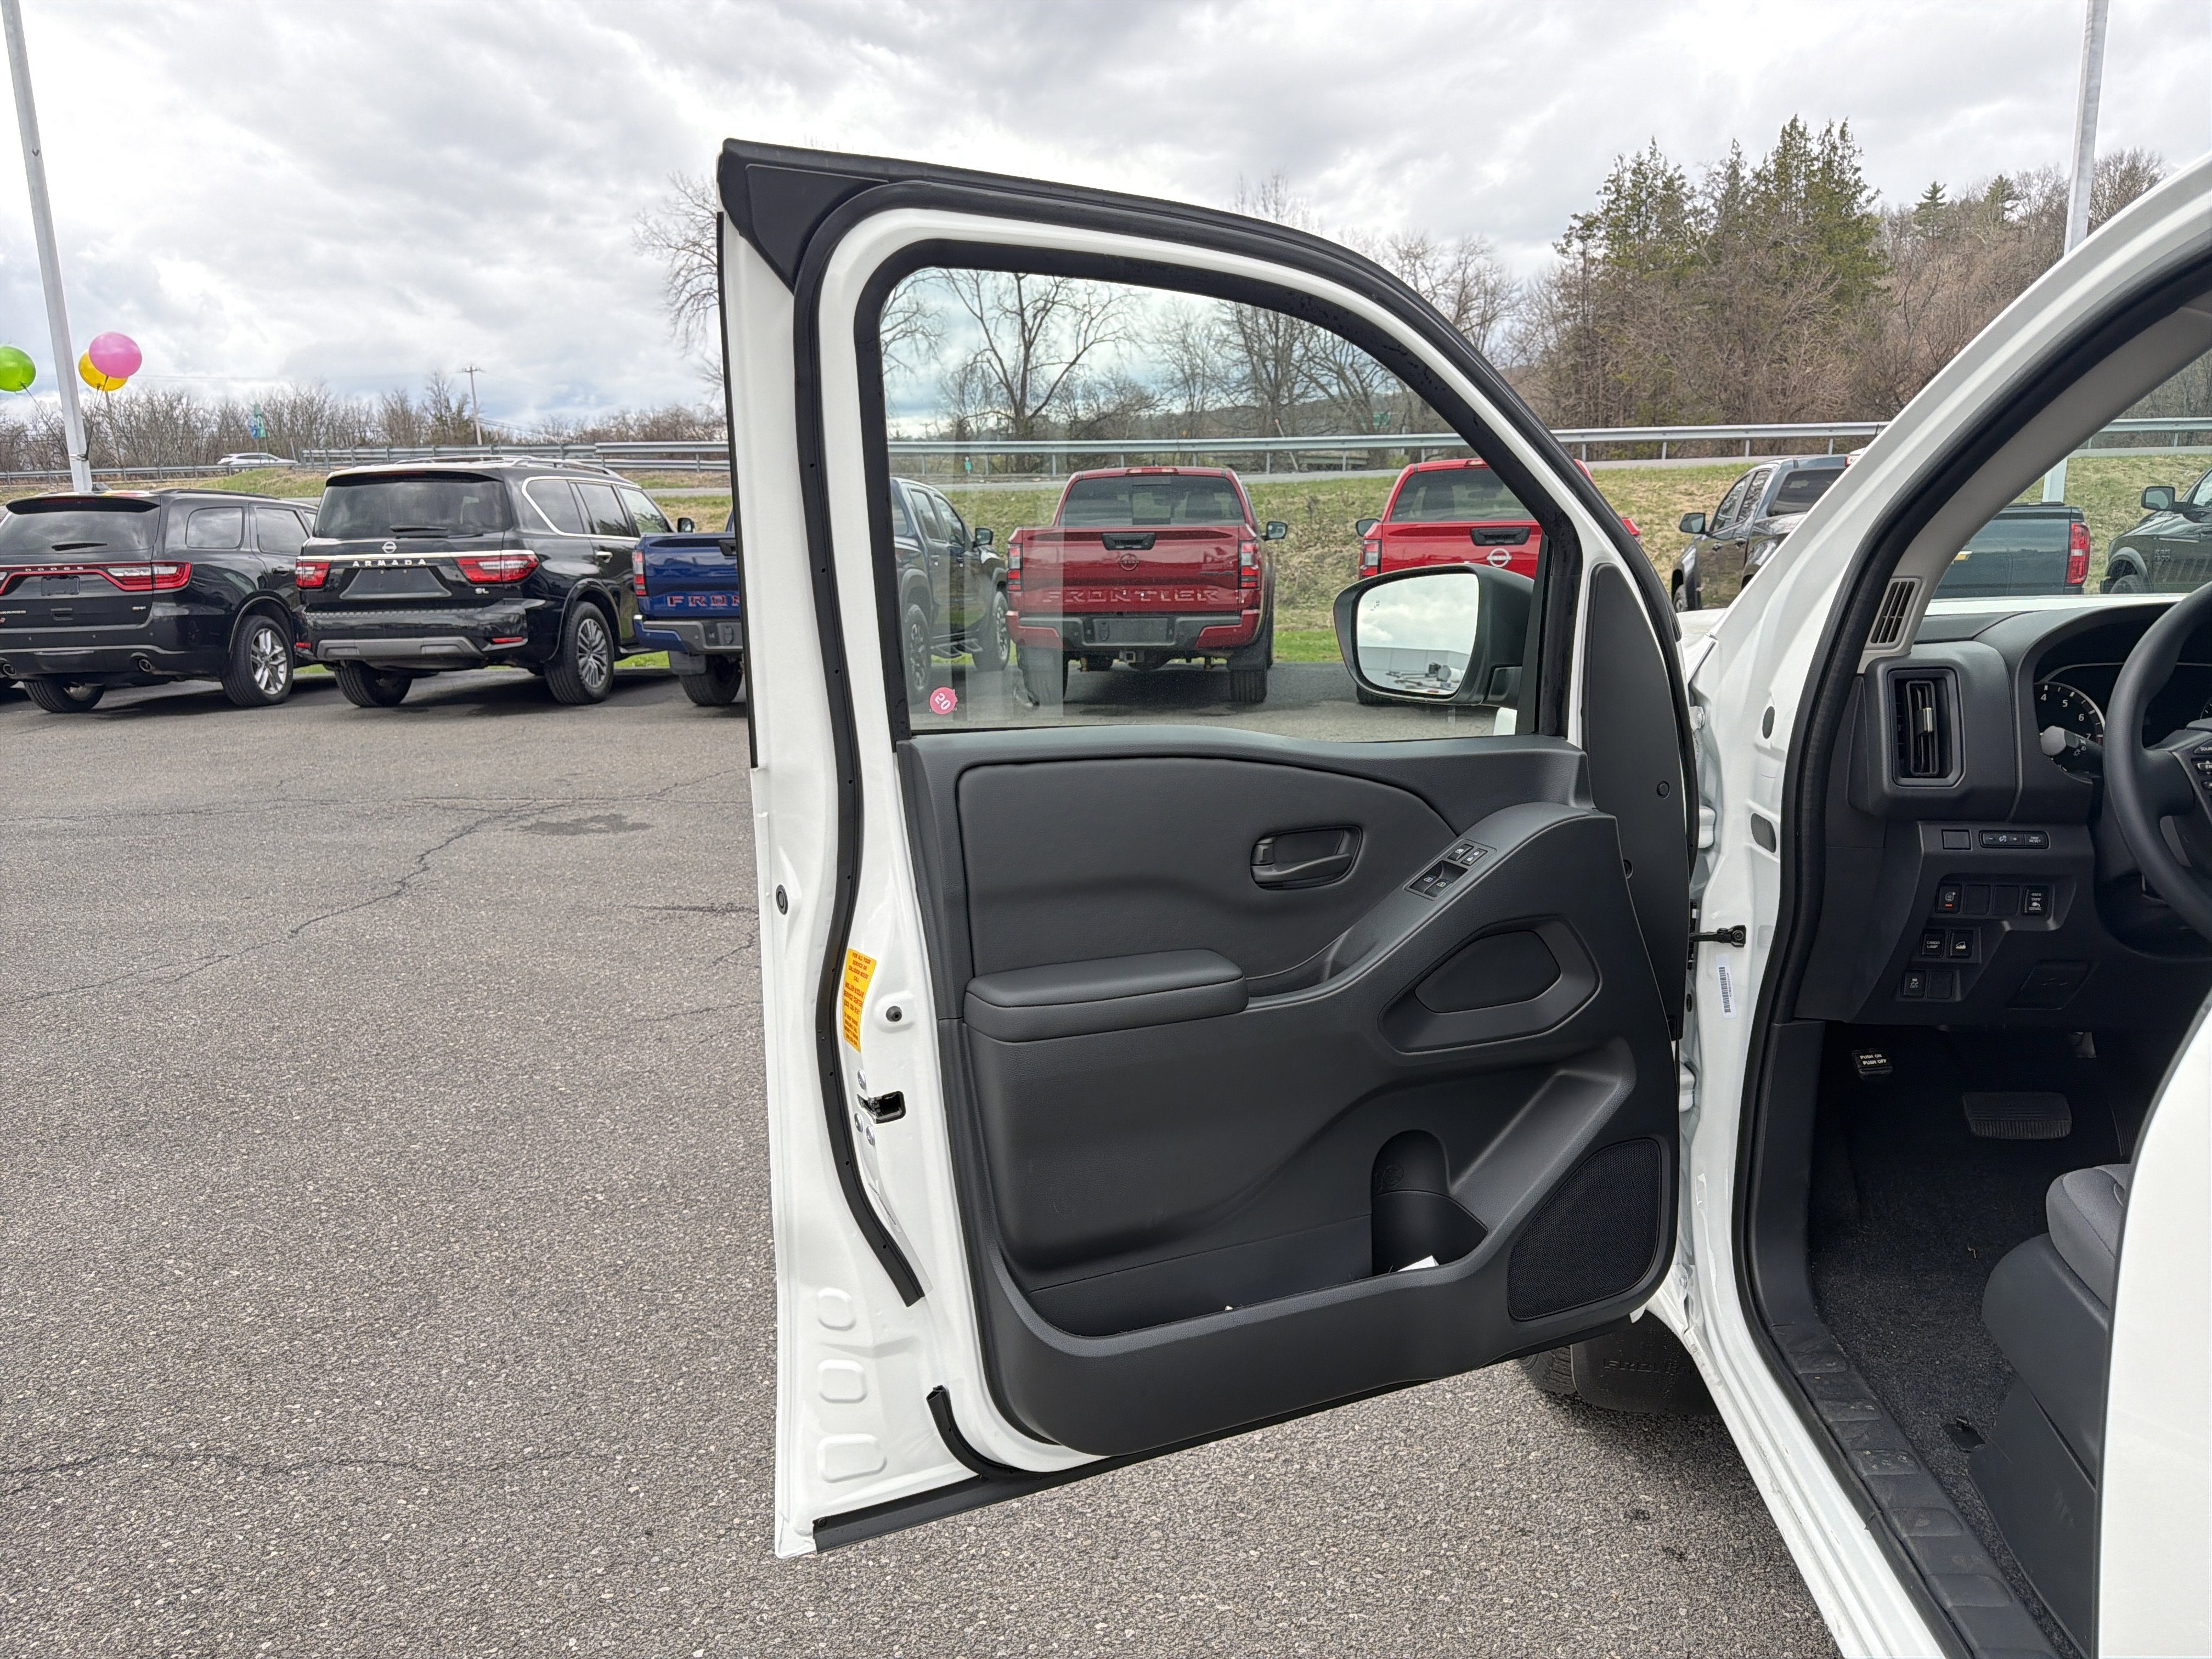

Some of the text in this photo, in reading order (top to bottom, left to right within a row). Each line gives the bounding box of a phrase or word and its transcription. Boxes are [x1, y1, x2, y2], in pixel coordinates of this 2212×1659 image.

[352, 558, 426, 567] ARMADA
[1042, 589, 1219, 602] FRONTIER
[2078, 713, 2085, 721] 6
